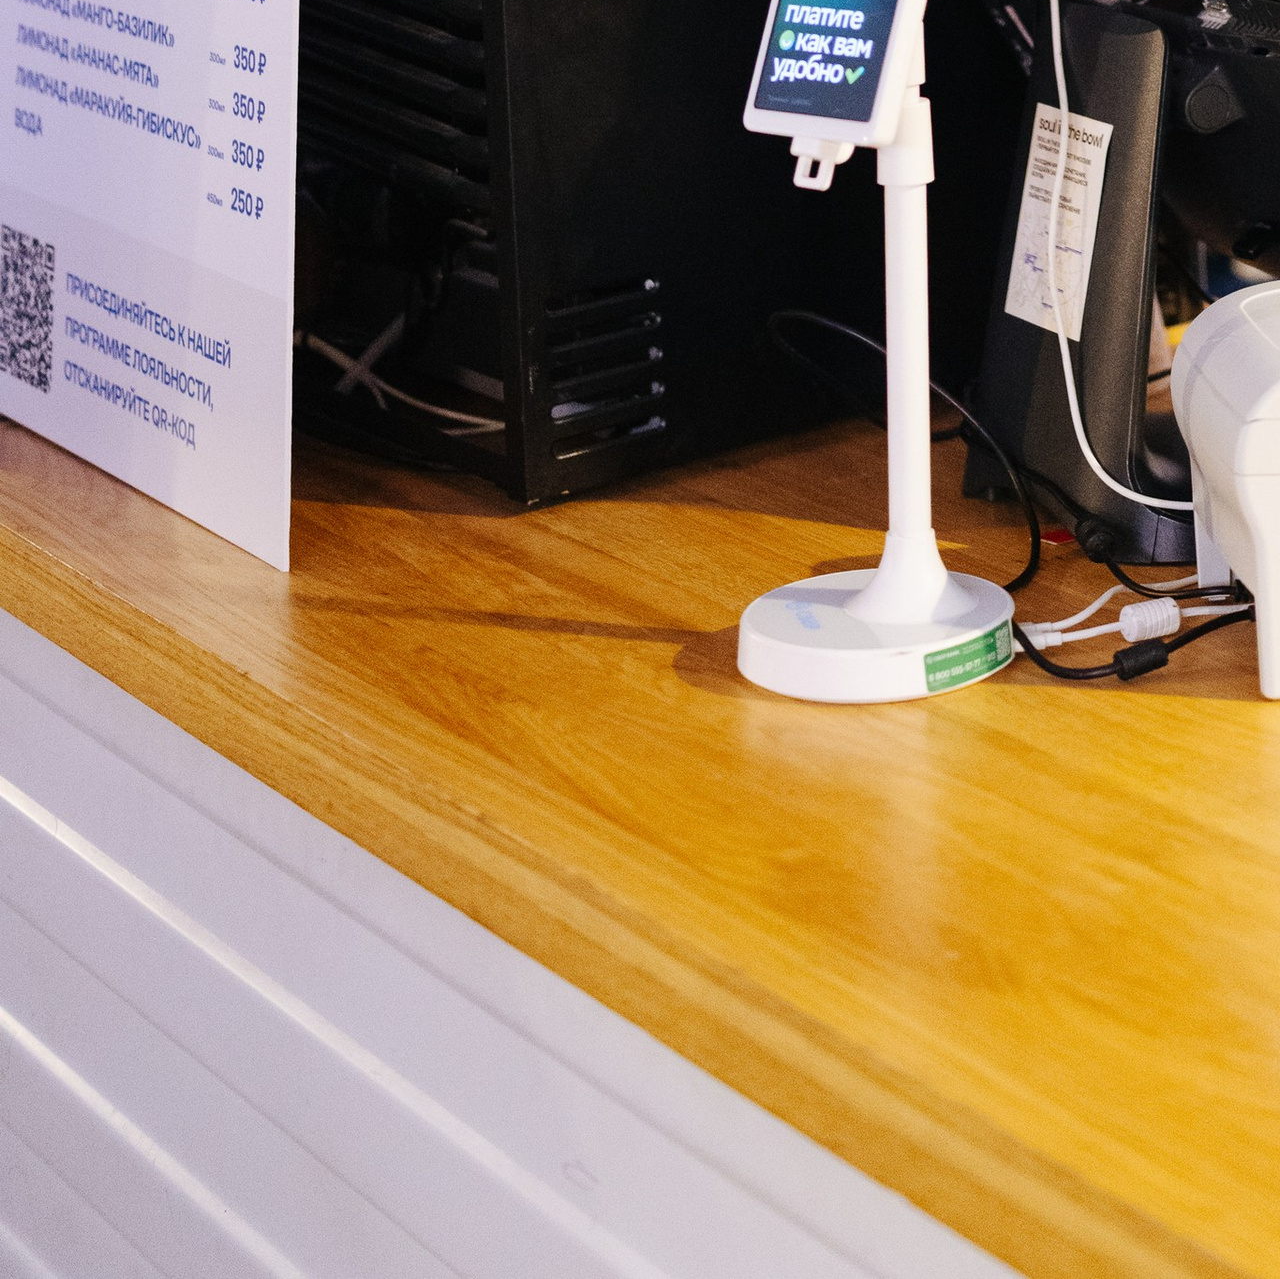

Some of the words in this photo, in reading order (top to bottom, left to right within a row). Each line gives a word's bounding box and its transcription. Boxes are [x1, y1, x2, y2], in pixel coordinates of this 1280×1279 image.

[784, 4, 865, 30] платите
[16, 23, 70, 61] ЛИМОНАД
[70, 40, 160, 89] «АНАНАС-МЯТА»
[233, 44, 256, 73] 350
[257, 52, 267, 76] ₽
[795, 32, 831, 54] как
[833, 35, 873, 59] вам
[770, 54, 844, 83] удобно
[14, 65, 69, 106] ЛИМОНАД
[69, 84, 202, 151] «МАРАКУЙЯ-ГИБИСКУС»
[14, 107, 43, 137] ВОДА
[232, 91, 255, 121] 350
[256, 99, 266, 124] ₽
[1040, 118, 1056, 133] soul
[1082, 127, 1105, 149] bowl
[231, 138, 254, 169] 350
[255, 147, 265, 172] ₽
[230, 186, 253, 217] 250
[255, 195, 264, 220] ₽
[66, 271, 176, 343] ПРИСОЕДИНЯЙТЕСЬ
[177, 323, 186, 347] К
[186, 331, 232, 369] НАШЕЙ
[65, 315, 132, 369] ПРОГРАММЕ
[132, 347, 214, 412] ЛОЯЛЬНОСТИ,
[64, 358, 150, 426] ОТСКАНИРУЙТЕ
[151, 406, 196, 451] QR-КОД
